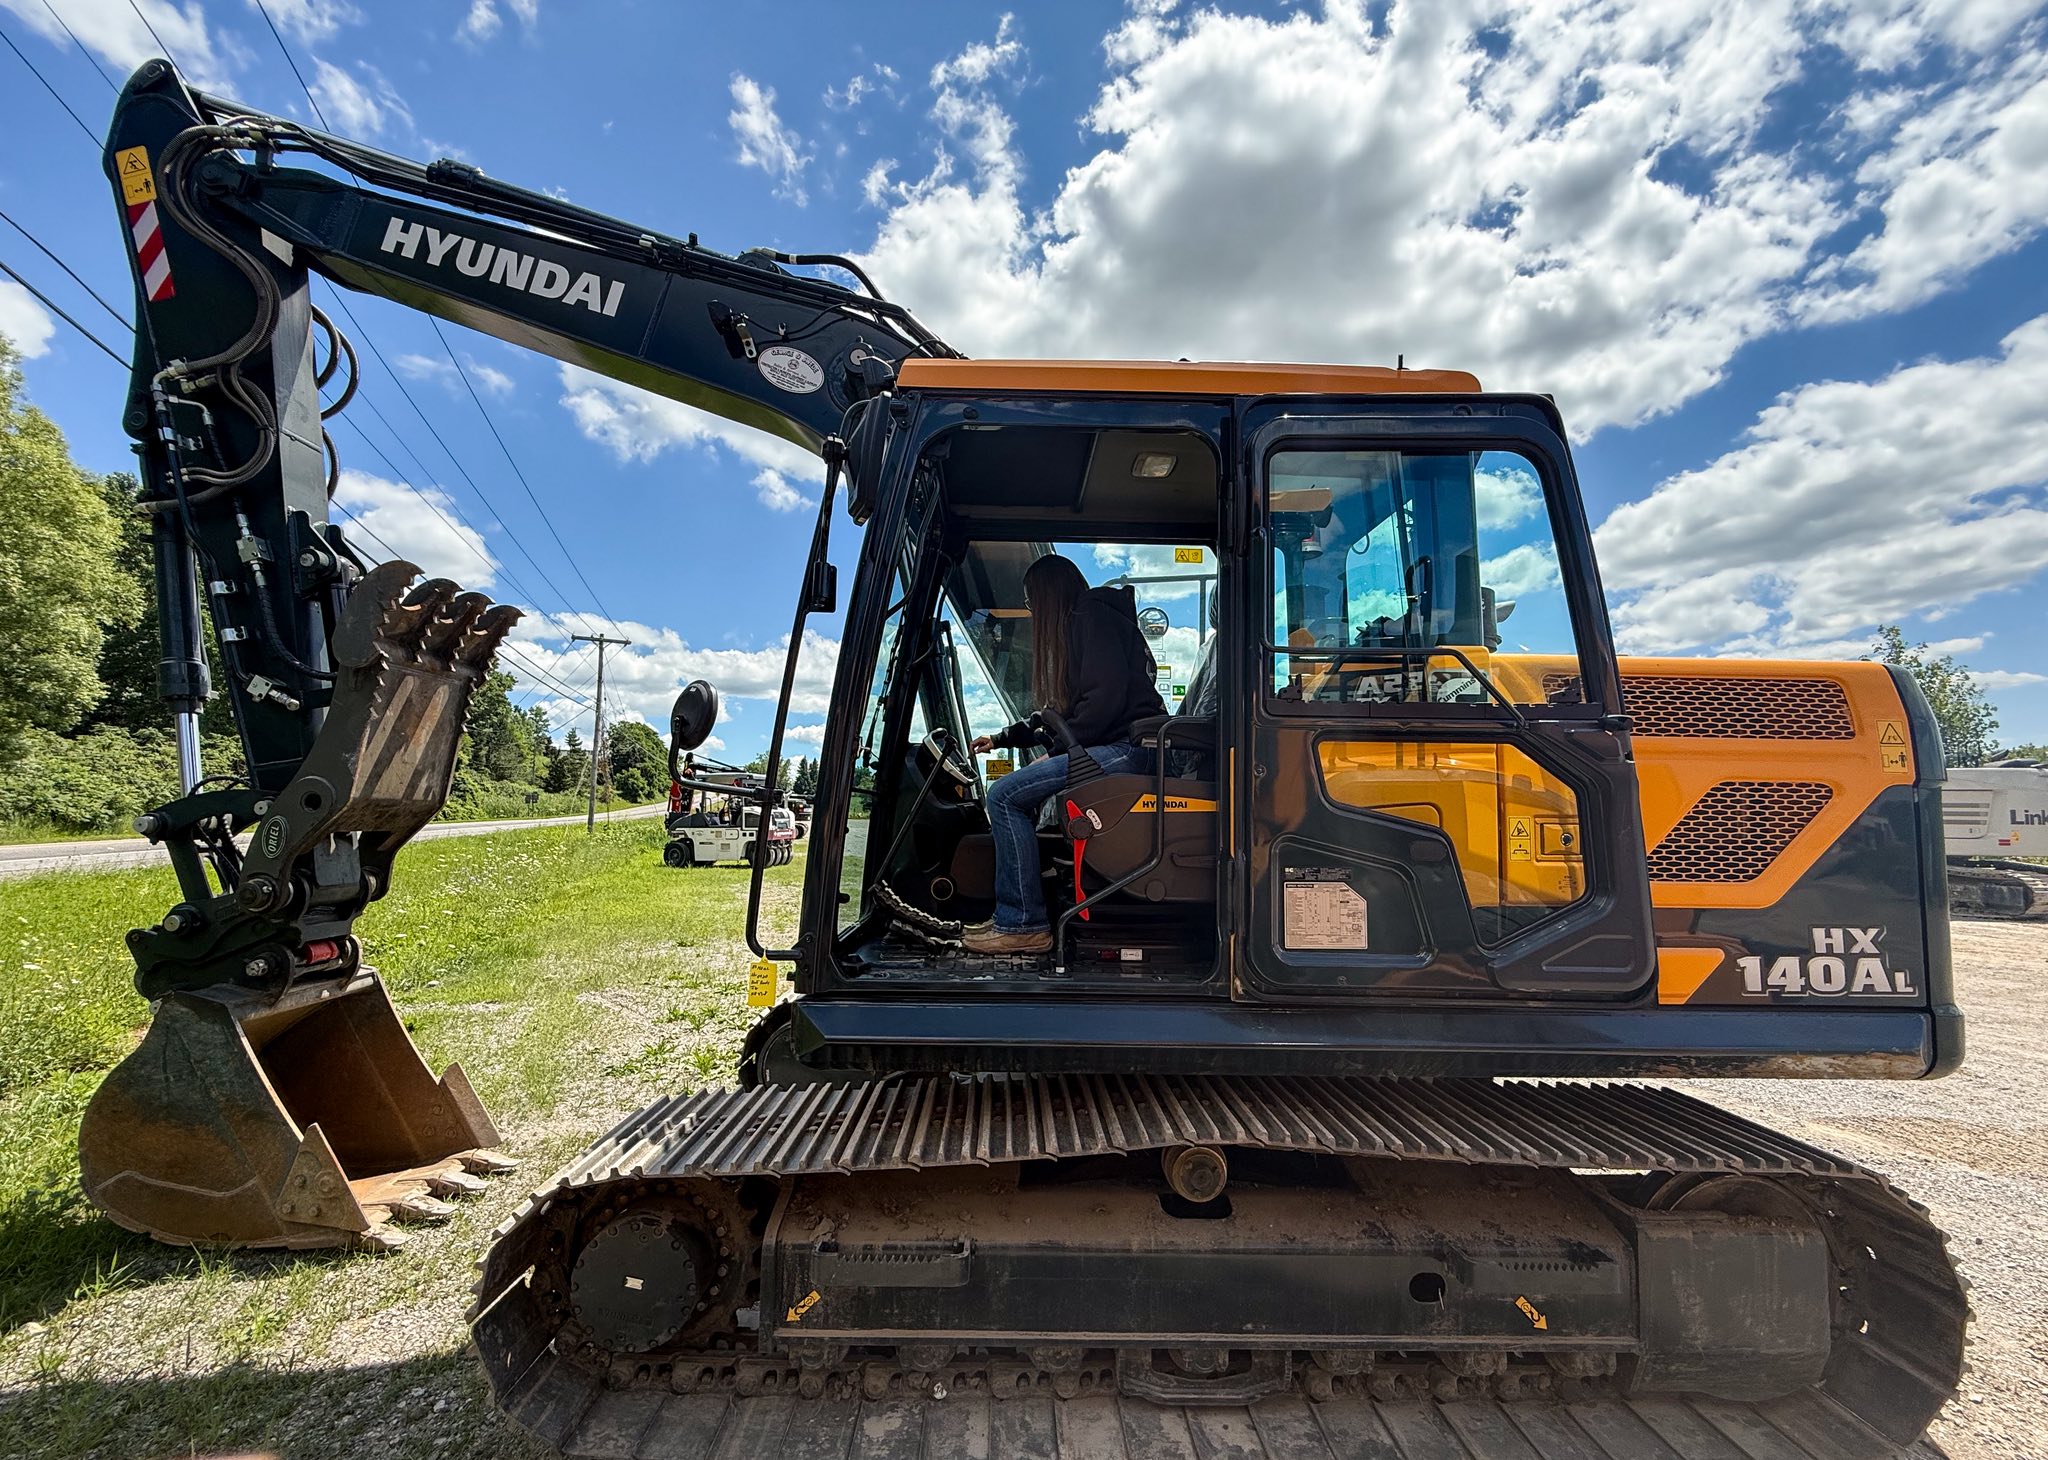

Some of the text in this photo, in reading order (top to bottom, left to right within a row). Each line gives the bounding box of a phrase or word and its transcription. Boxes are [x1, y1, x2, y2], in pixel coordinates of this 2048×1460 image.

[380, 216, 626, 317] HYUNDAI
[1142, 801, 1187, 809] HYNDAI
[267, 825, 280, 852] ORIEL
[1812, 926, 1881, 954] HX
